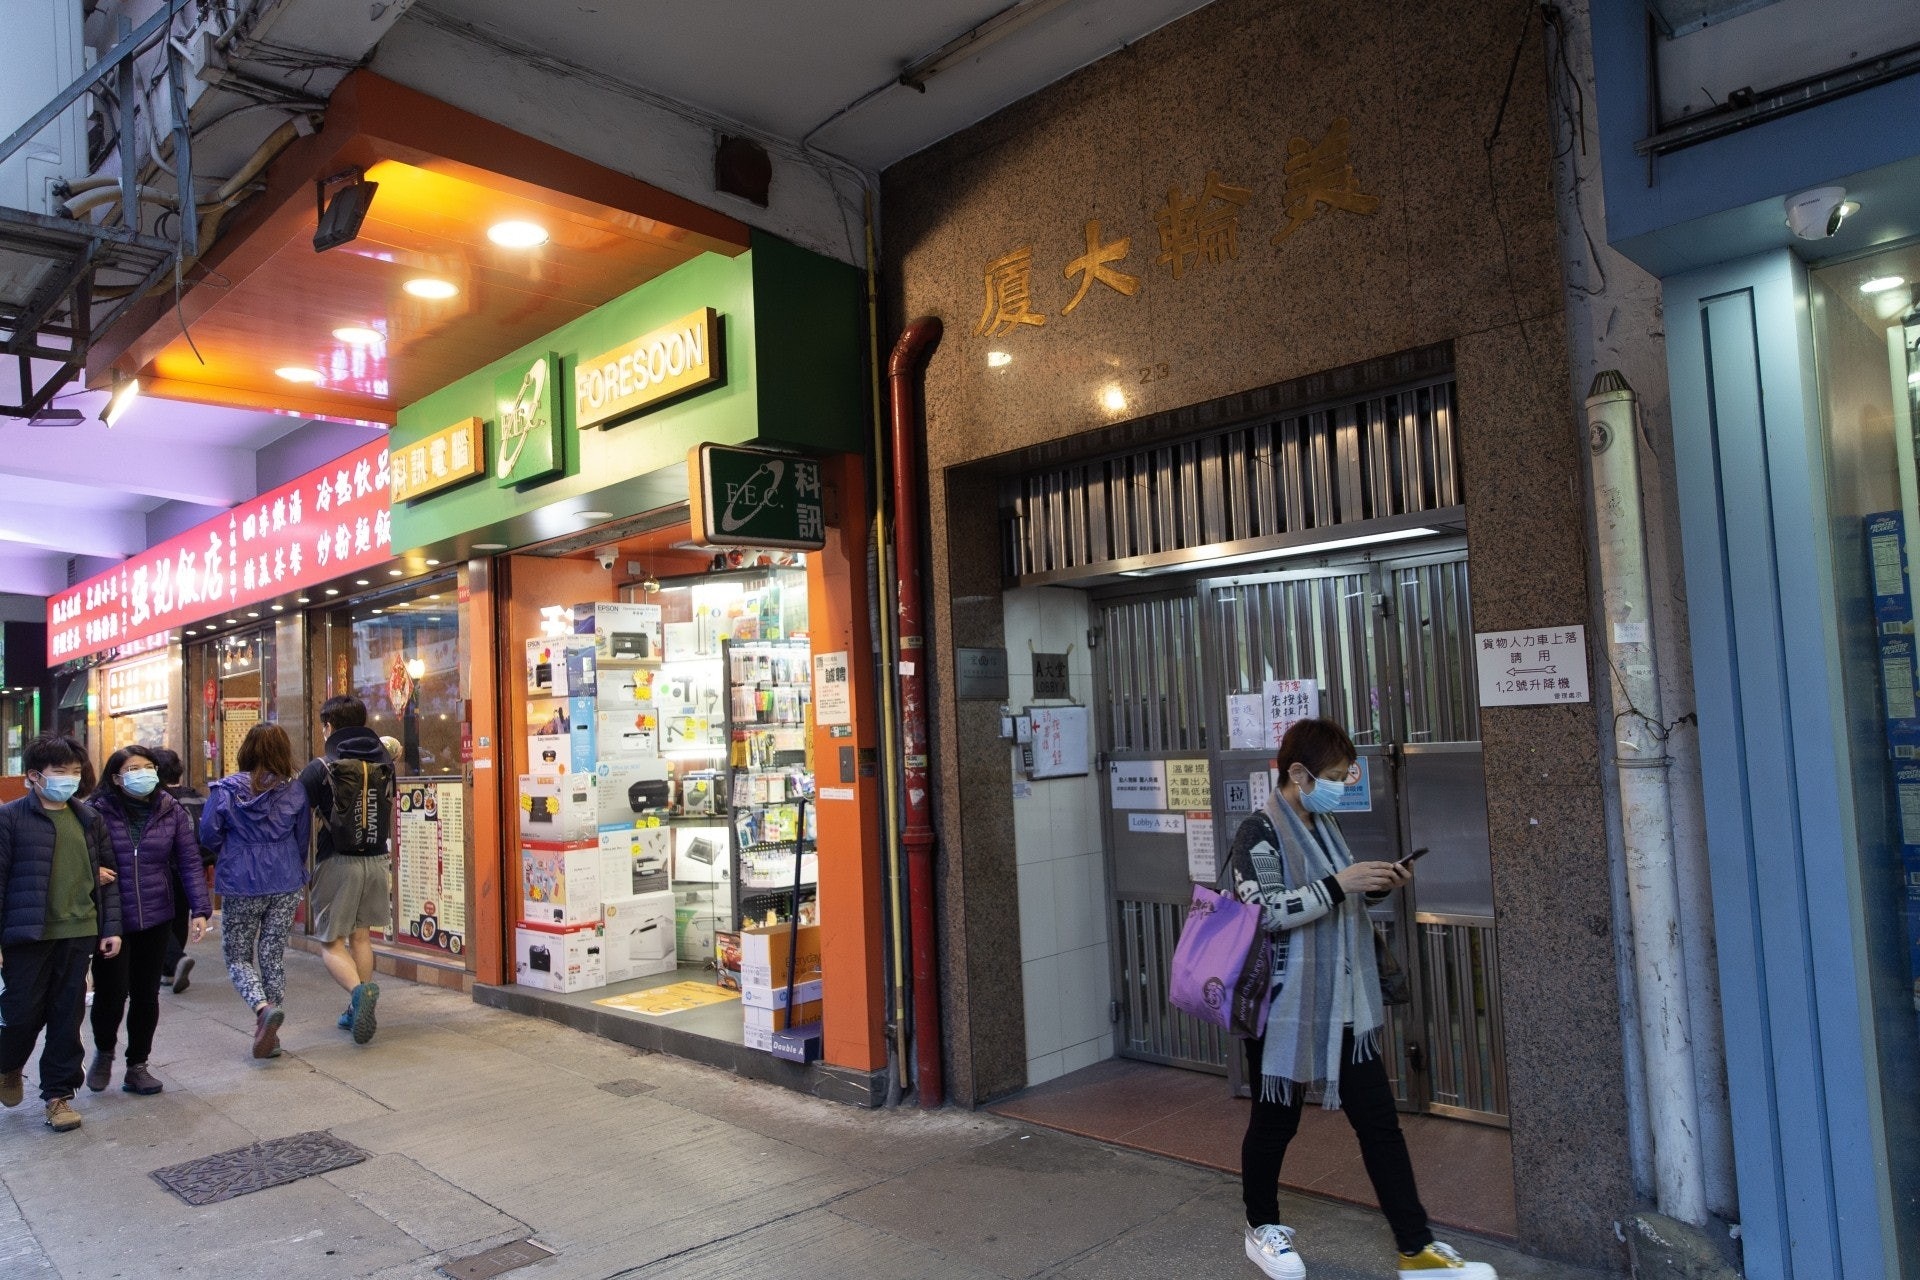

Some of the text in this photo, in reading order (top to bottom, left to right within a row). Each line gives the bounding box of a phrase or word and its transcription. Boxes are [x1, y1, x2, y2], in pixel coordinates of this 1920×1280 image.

[576, 322, 704, 414] FORESOON
[1139, 363, 1170, 386] 23
[391, 427, 470, 492] 科訊電腦
[793, 462, 824, 539] 科訊
[597, 604, 619, 612] EPSON
[527, 640, 541, 648] EPSON
[1482, 631, 1577, 650] 貨物人力車上落
[1510, 649, 1550, 663] 請 用
[825, 666, 846, 684] 誠聘
[1036, 680, 1059, 693] LOBBY
[1278, 680, 1301, 692] 訪客
[1495, 677, 1571, 694] 1,2號升降機
[1230, 786, 1244, 802] 拉
[366, 788, 378, 844] ULTIMATE
[1132, 817, 1180, 829] Lobby A 大堂
[773, 1040, 804, 1056] Double A
